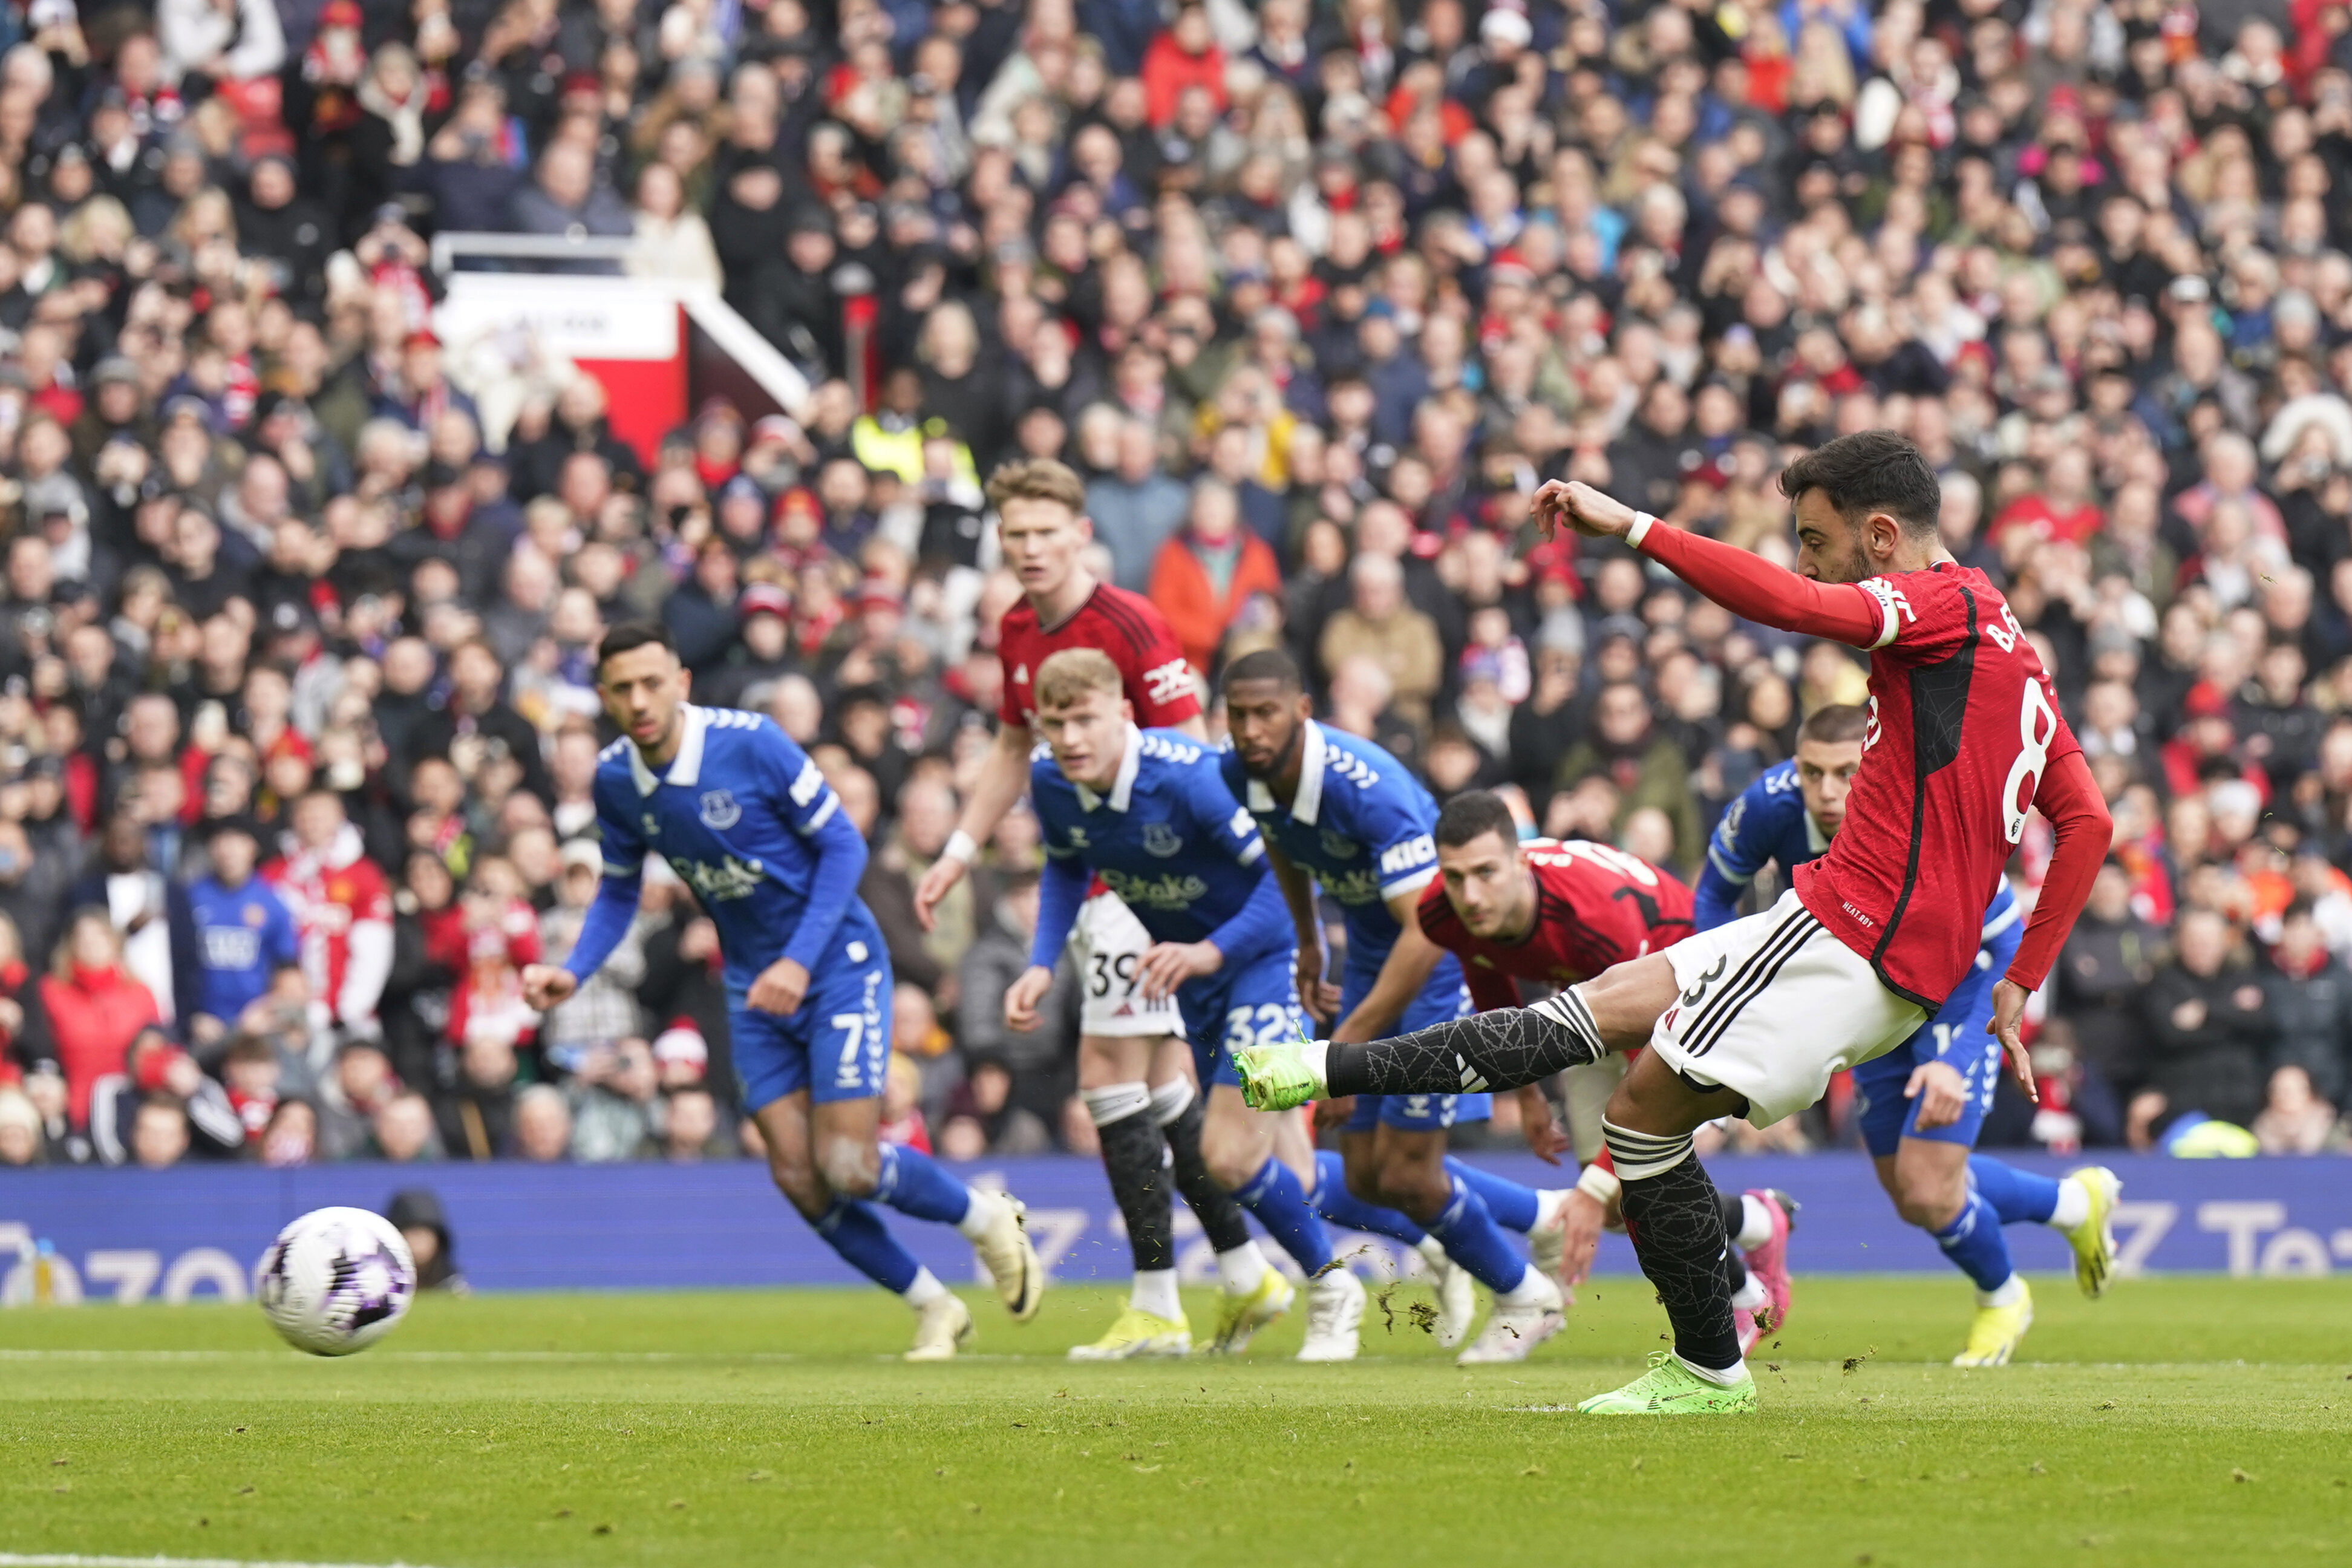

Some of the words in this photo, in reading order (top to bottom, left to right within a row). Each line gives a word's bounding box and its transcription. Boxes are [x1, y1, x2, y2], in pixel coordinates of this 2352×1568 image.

[2002, 676, 2057, 845] 8
[1842, 901, 1874, 928] HEAT.RDY
[1091, 953, 1138, 997] 39
[831, 1013, 864, 1063] 7
[1224, 1002, 1289, 1056] 32
